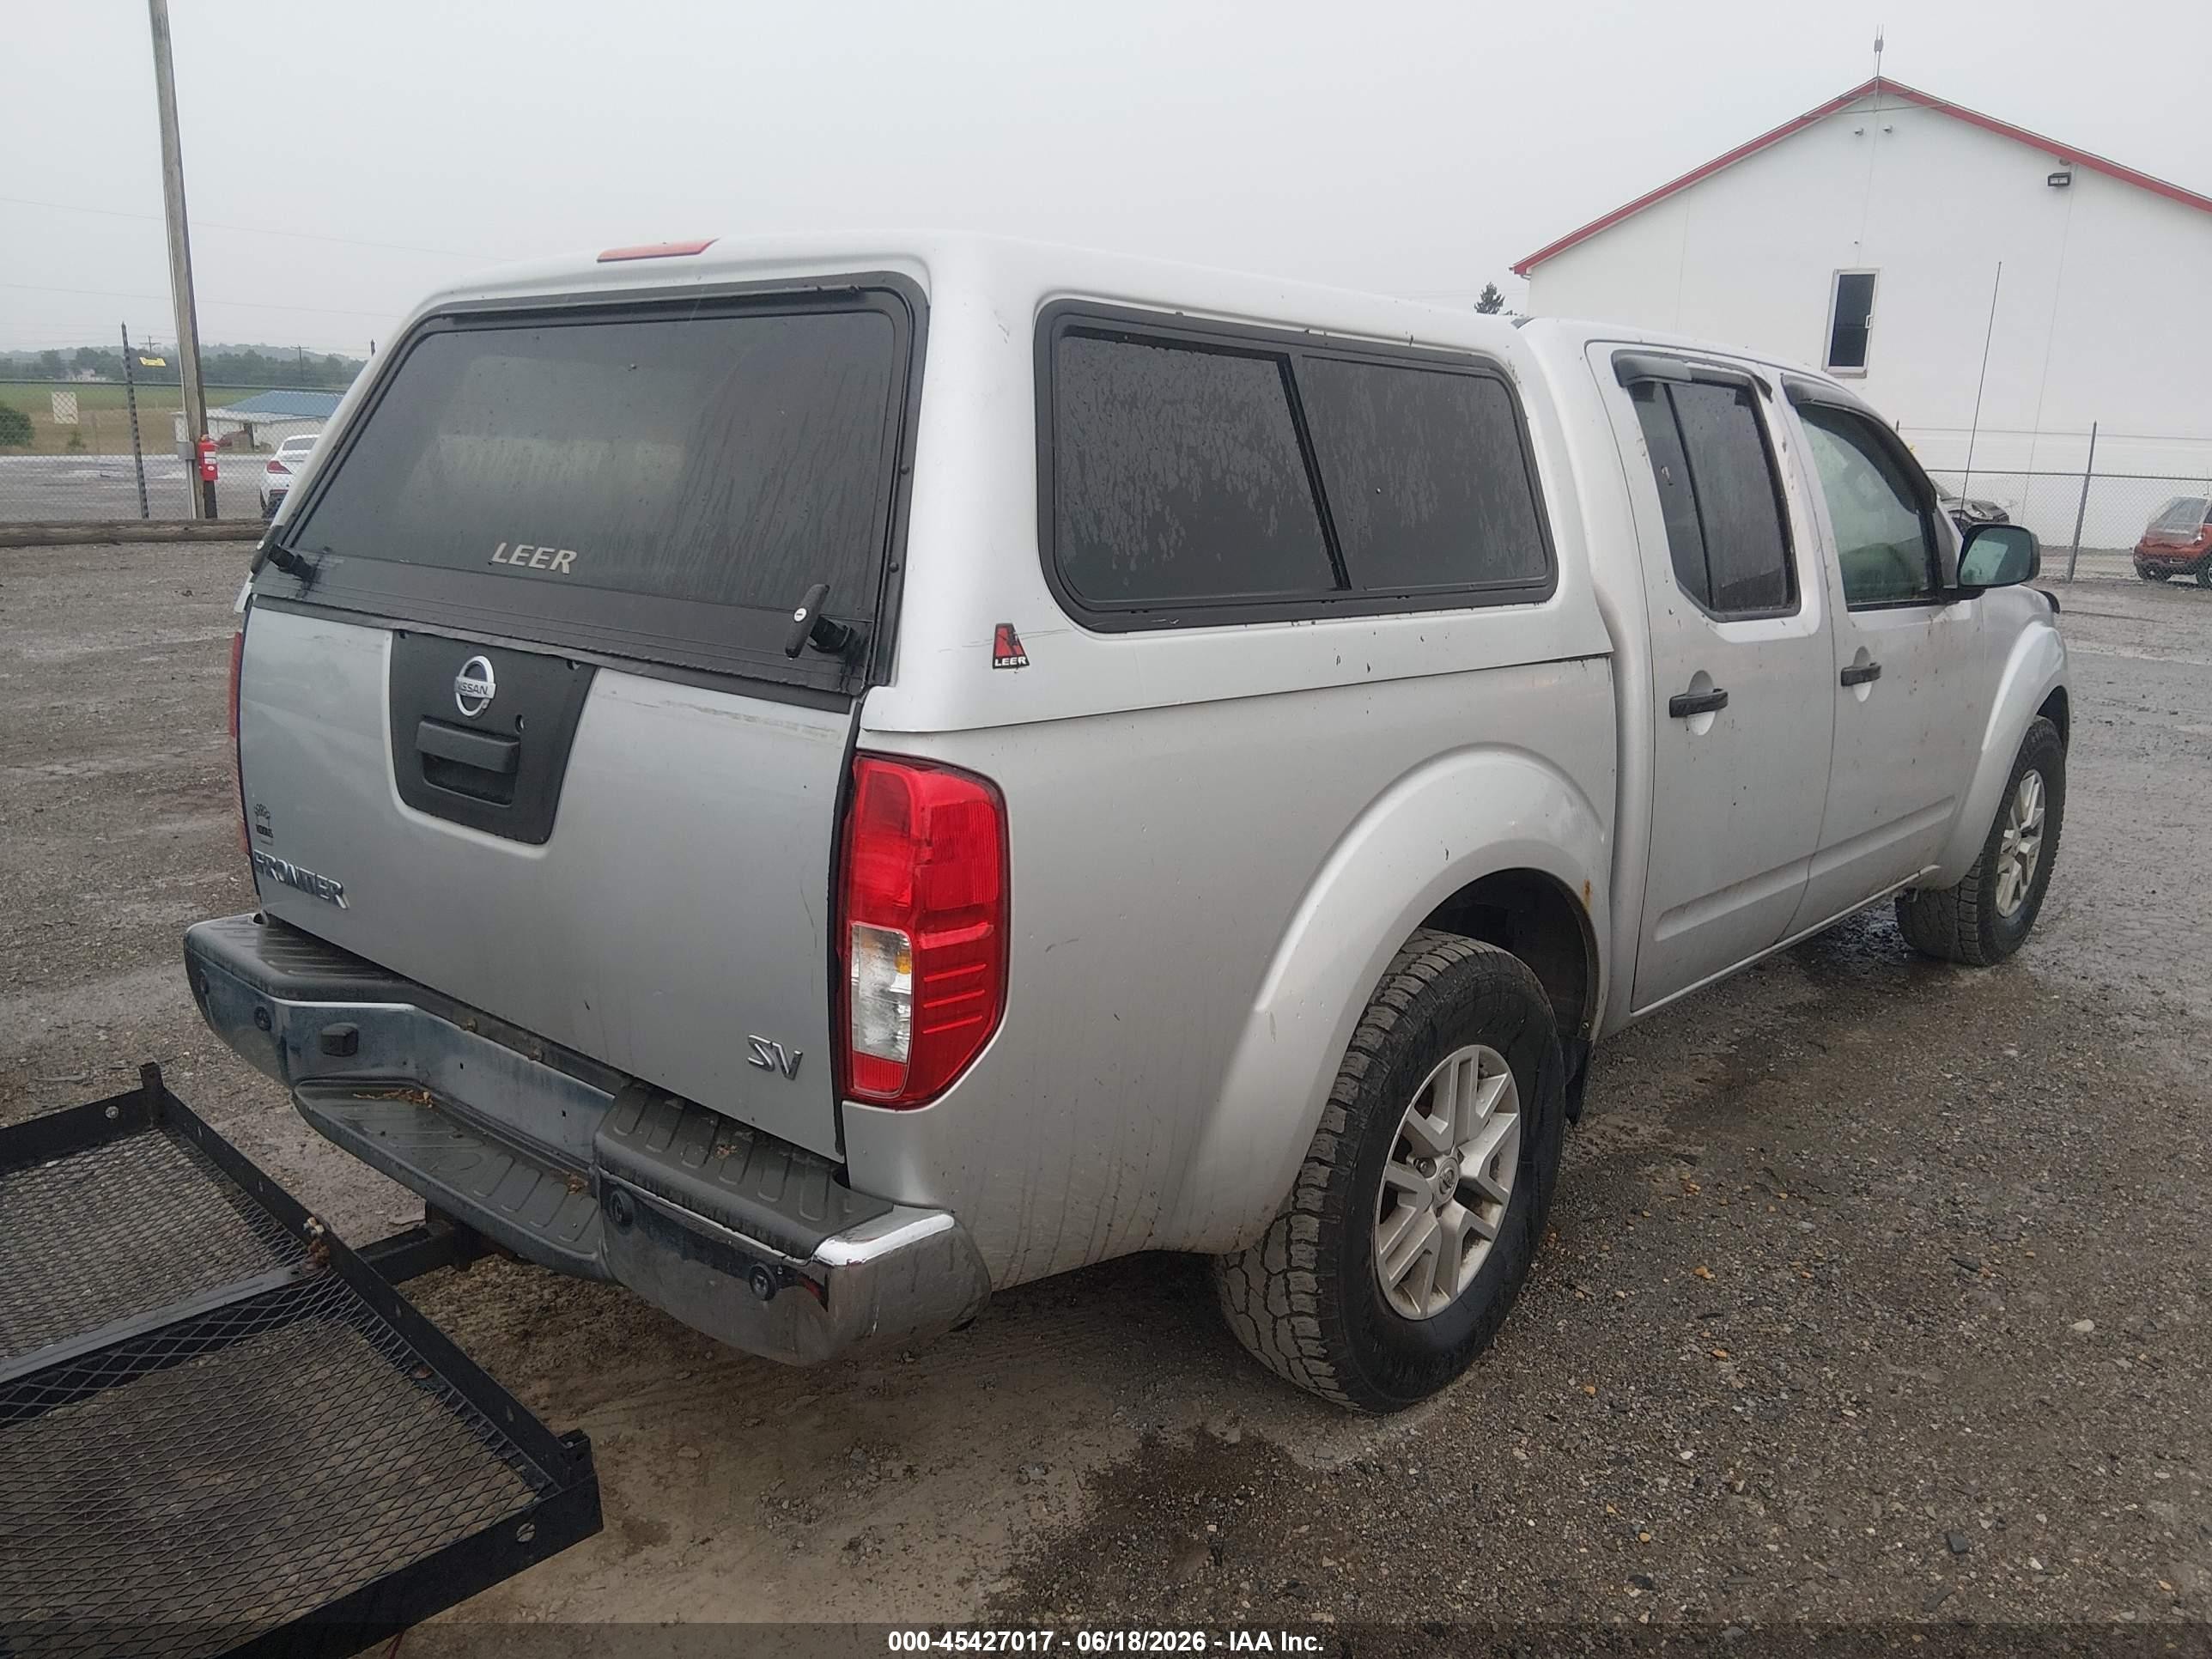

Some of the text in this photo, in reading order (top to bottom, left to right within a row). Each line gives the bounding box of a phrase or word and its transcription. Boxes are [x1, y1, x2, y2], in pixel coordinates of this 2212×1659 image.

[491, 542, 578, 574] LEER
[994, 656, 1027, 667] LEER
[253, 848, 349, 909] FRONTIER
[747, 1034, 804, 1081] SV
